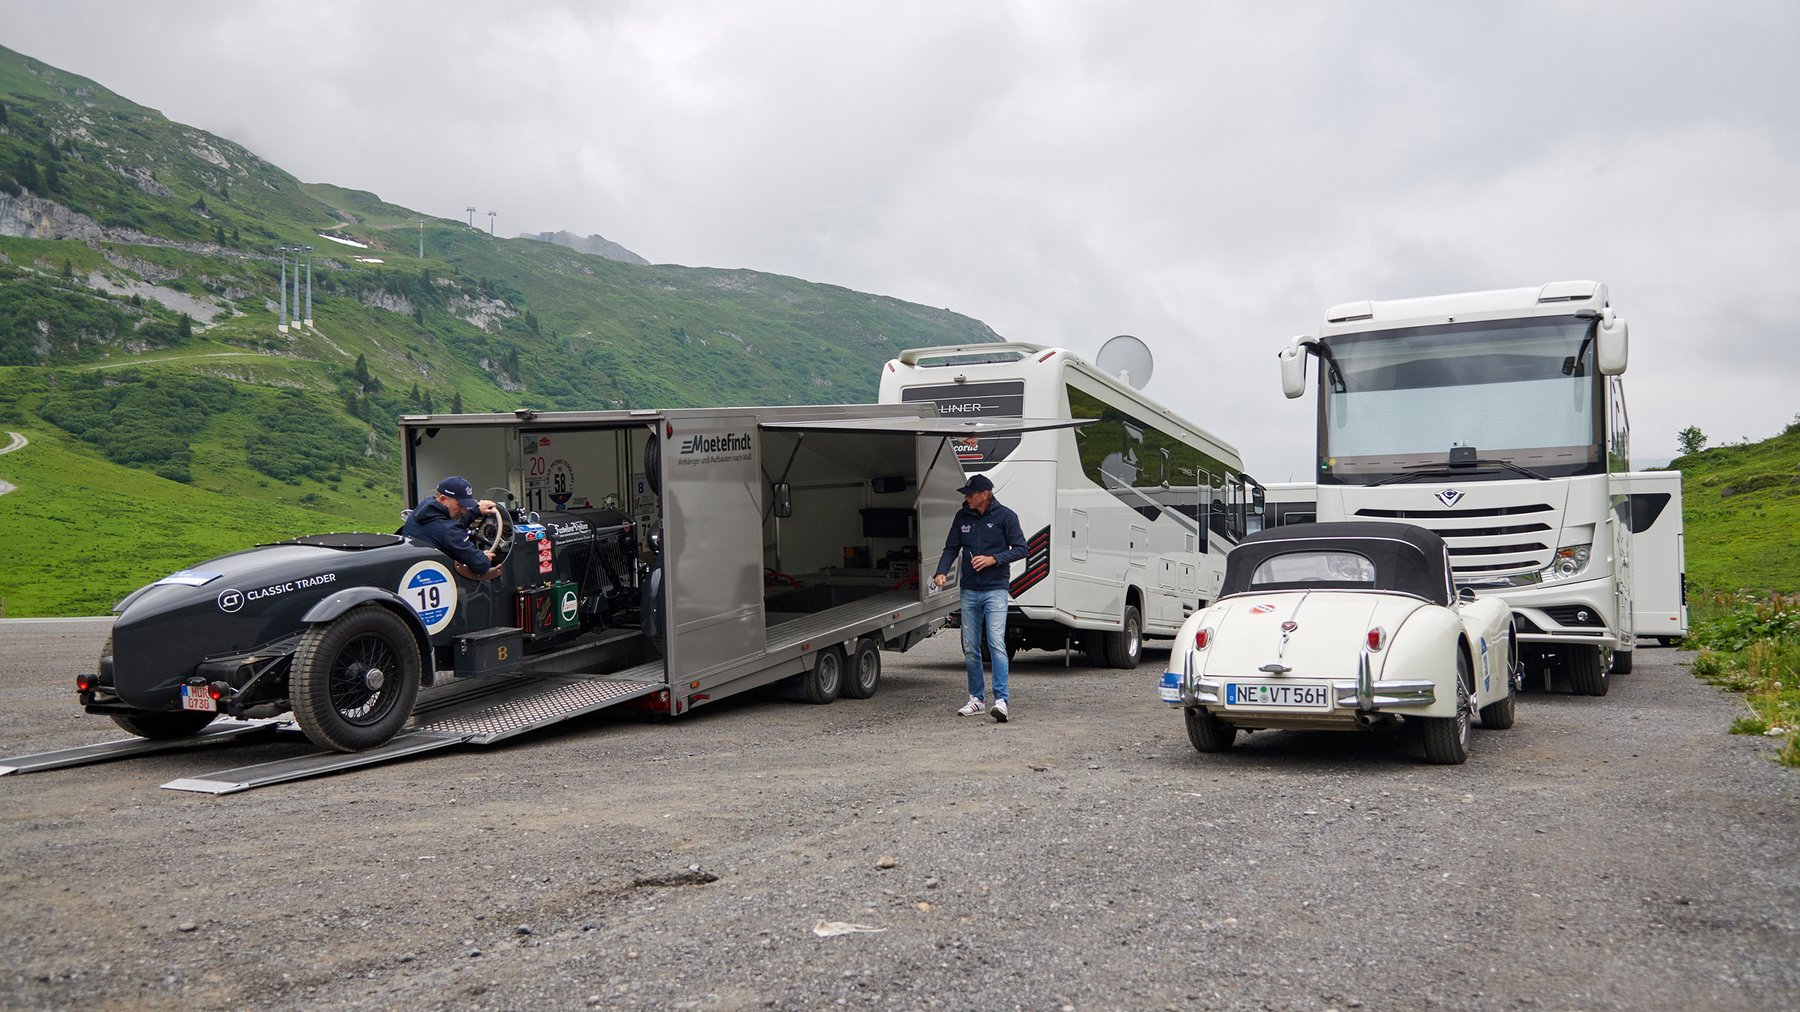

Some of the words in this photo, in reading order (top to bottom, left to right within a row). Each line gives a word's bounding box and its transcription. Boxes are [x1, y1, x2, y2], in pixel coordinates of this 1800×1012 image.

[940, 403, 981, 413] LINER
[690, 433, 751, 453] Moetefindt
[530, 456, 545, 476] 20
[701, 456, 710, 464] und
[554, 473, 566, 493] 58
[638, 482, 644, 493] 8
[526, 488, 542, 511] 11
[247, 582, 294, 601] CLASSIC
[295, 573, 337, 589] TRADER
[222, 594, 240, 607] CT
[417, 586, 440, 610] 19
[497, 646, 508, 661] B
[1237, 687, 1258, 702] NE
[1270, 687, 1290, 703] VT
[1294, 688, 1326, 704] 56H
